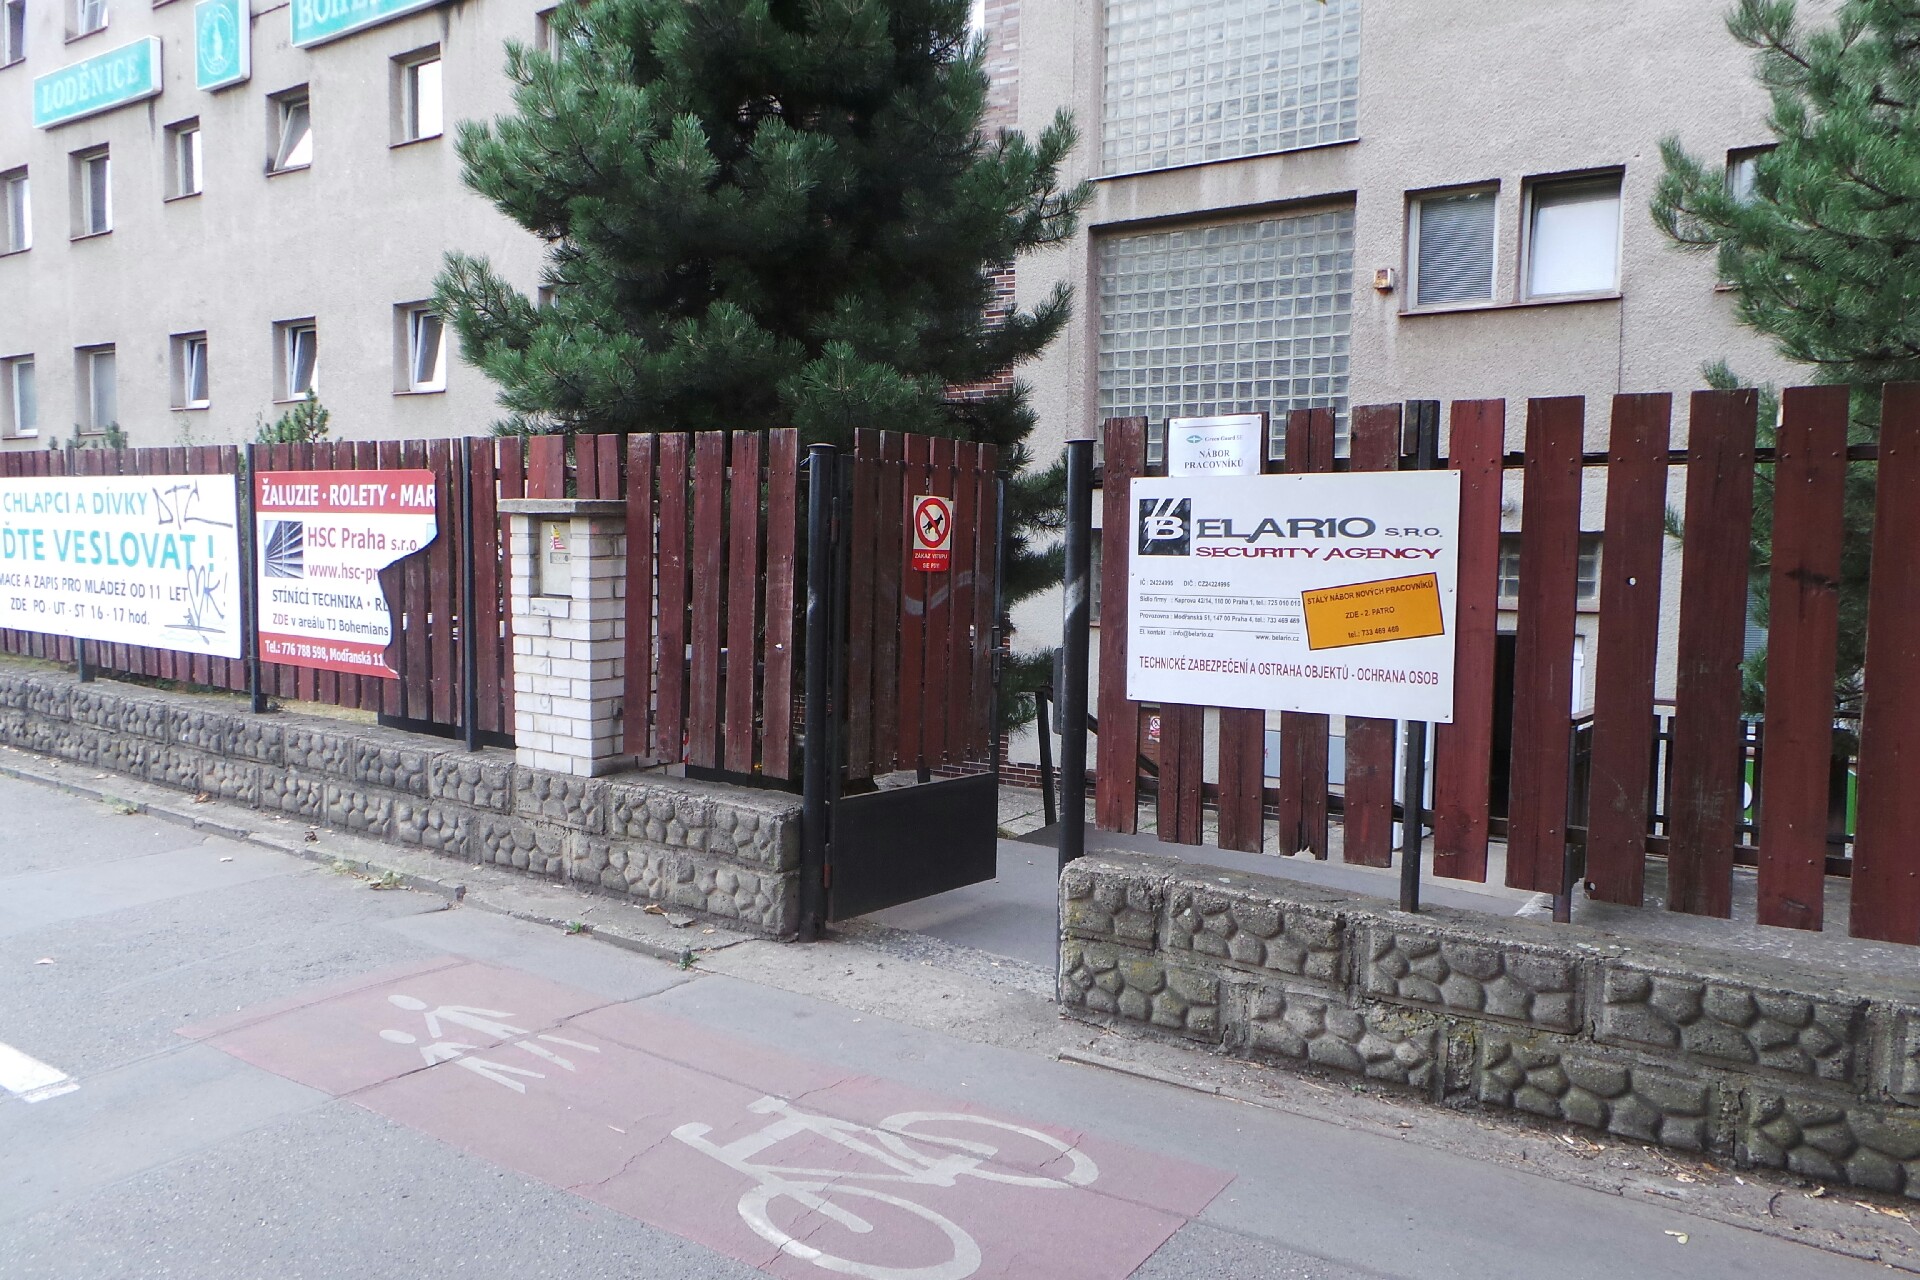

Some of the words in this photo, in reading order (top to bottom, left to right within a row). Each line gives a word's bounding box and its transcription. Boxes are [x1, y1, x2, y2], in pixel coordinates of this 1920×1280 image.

[42, 54, 139, 114] LODĚNICE
[1184, 458, 1244, 469] PRACOVNÍKŮ
[1198, 448, 1230, 458] NÁBOR
[3, 491, 70, 514] CHLAPCI
[75, 492, 86, 515] A
[93, 486, 148, 516] DÍVKY
[262, 478, 319, 506] ŽALUZIE
[329, 484, 389, 507] ROLETY
[307, 526, 337, 549] HSC
[341, 527, 386, 551] Praha
[391, 537, 422, 552] s.r.o.
[1384, 527, 1443, 538] S.R.O.
[53, 528, 196, 571] VESLOVAT
[1196, 546, 1319, 558] SECURITY
[1323, 547, 1443, 561] AGENCY
[24, 574, 31, 588] A
[62, 576, 82, 592] PRO
[129, 582, 146, 599] OD
[149, 584, 161, 600] 11
[169, 585, 189, 602] LET
[272, 585, 310, 606] STÍNÍCÍ
[312, 591, 364, 611] TECHNIKA
[1307, 595, 1329, 605] STÁLÝ
[1330, 592, 1354, 602] NÁBOR
[1356, 588, 1385, 599] NOVÝCH
[1385, 580, 1434, 595] PRACOVNÍKŮ
[10, 597, 27, 612] ZDE
[33, 599, 46, 614] PO
[74, 603, 86, 618] ST
[91, 604, 103, 620] 16
[113, 607, 125, 622] 17
[128, 608, 151, 626] hod.
[272, 612, 289, 626] ZDE
[291, 616, 297, 627] v
[298, 615, 325, 630] areálu
[327, 618, 336, 631] TJ
[339, 619, 389, 636] Bohemians
[1345, 611, 1359, 619] ZDE
[1372, 606, 1395, 616] PATRO
[1361, 629, 1373, 637] 733
[1374, 627, 1386, 635] 469
[265, 640, 280, 654] Tel.:
[281, 642, 296, 656] 776
[297, 644, 311, 658] 788
[329, 647, 372, 665] Modřanská
[1139, 654, 1186, 671] TECHNICKÉ
[1188, 657, 1248, 674] ZABEZPEČENÍ
[1250, 661, 1257, 674] A
[1258, 663, 1303, 678] OSTRAHA
[1304, 664, 1349, 681] OBJEKTŮ
[1357, 668, 1406, 684] OCHRANA
[1408, 671, 1439, 685] OSOB
